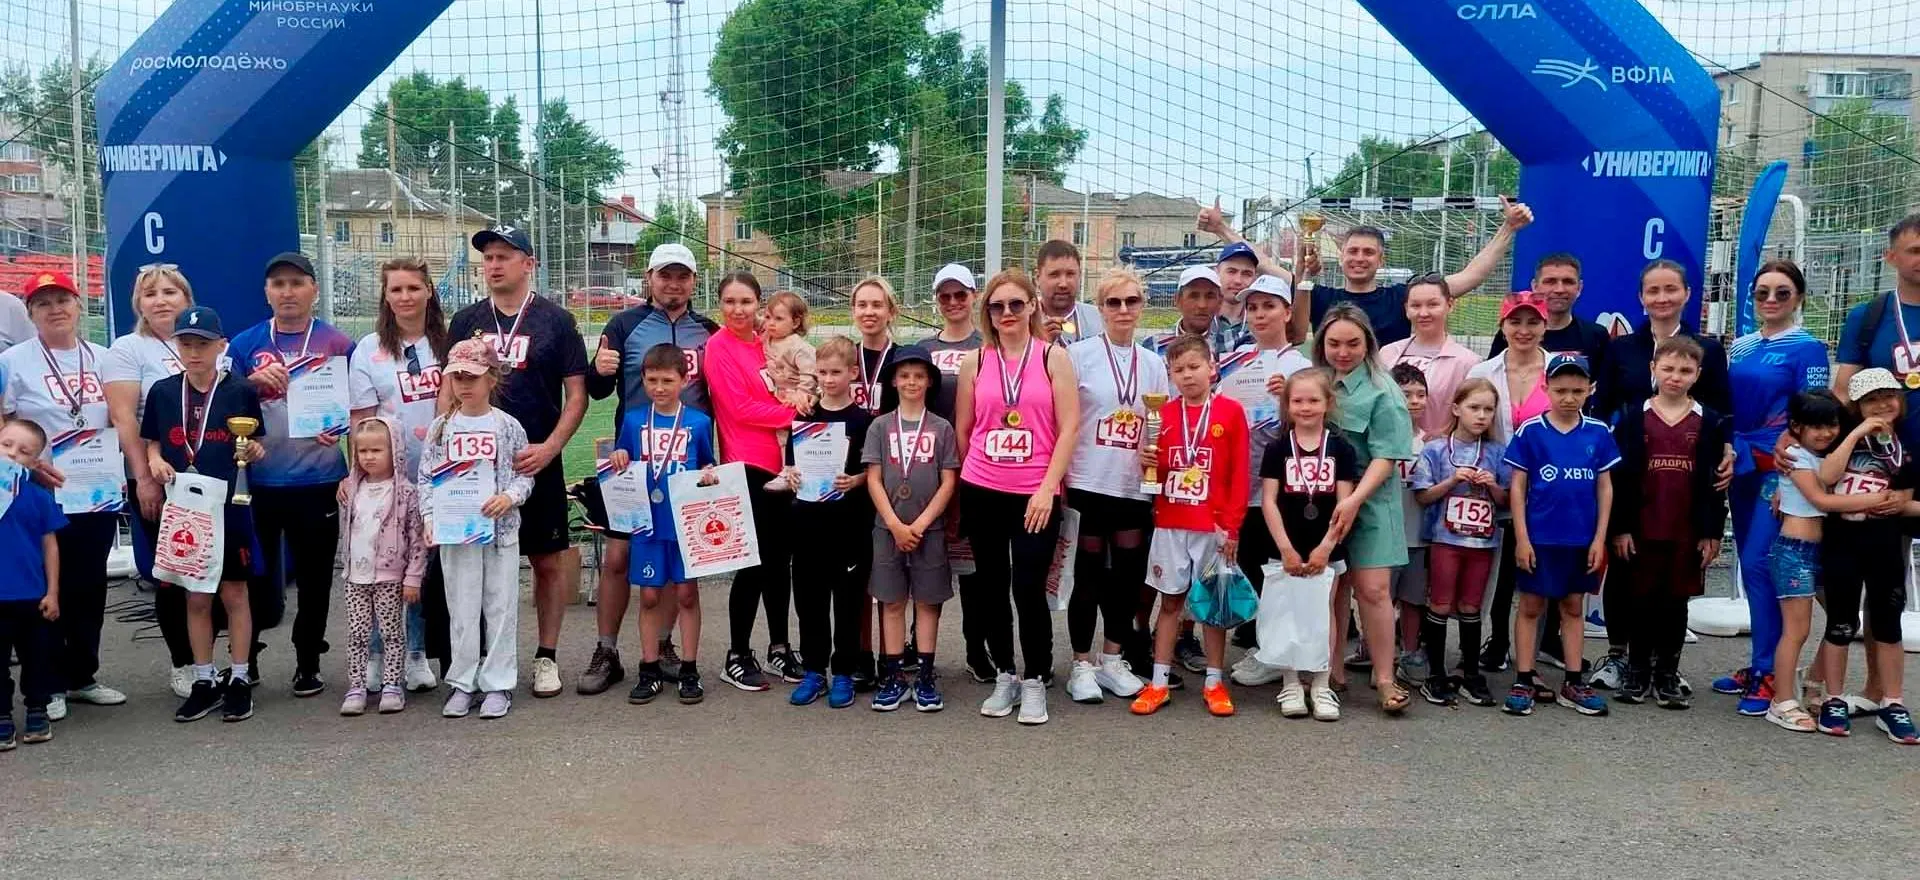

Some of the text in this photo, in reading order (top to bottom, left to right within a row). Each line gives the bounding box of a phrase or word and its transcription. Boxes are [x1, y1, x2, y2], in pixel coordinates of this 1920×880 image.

[249, 1, 374, 13] МИНОБРНАУКИ
[1457, 3, 1537, 20] СЛЛА
[277, 17, 345, 29] РОССИИ
[130, 52, 287, 76] росмолодёжь
[1611, 66, 1676, 84] ВФЛА
[103, 145, 218, 172] УНИВЕРЛИГА
[1592, 151, 1708, 177] УНИВЕРЛИГА
[404, 369, 441, 392] 140
[1104, 417, 1138, 440] 143
[453, 436, 495, 457] 135
[990, 433, 1028, 453] 144
[1842, 476, 1888, 495] 157
[1455, 500, 1491, 524] 152
